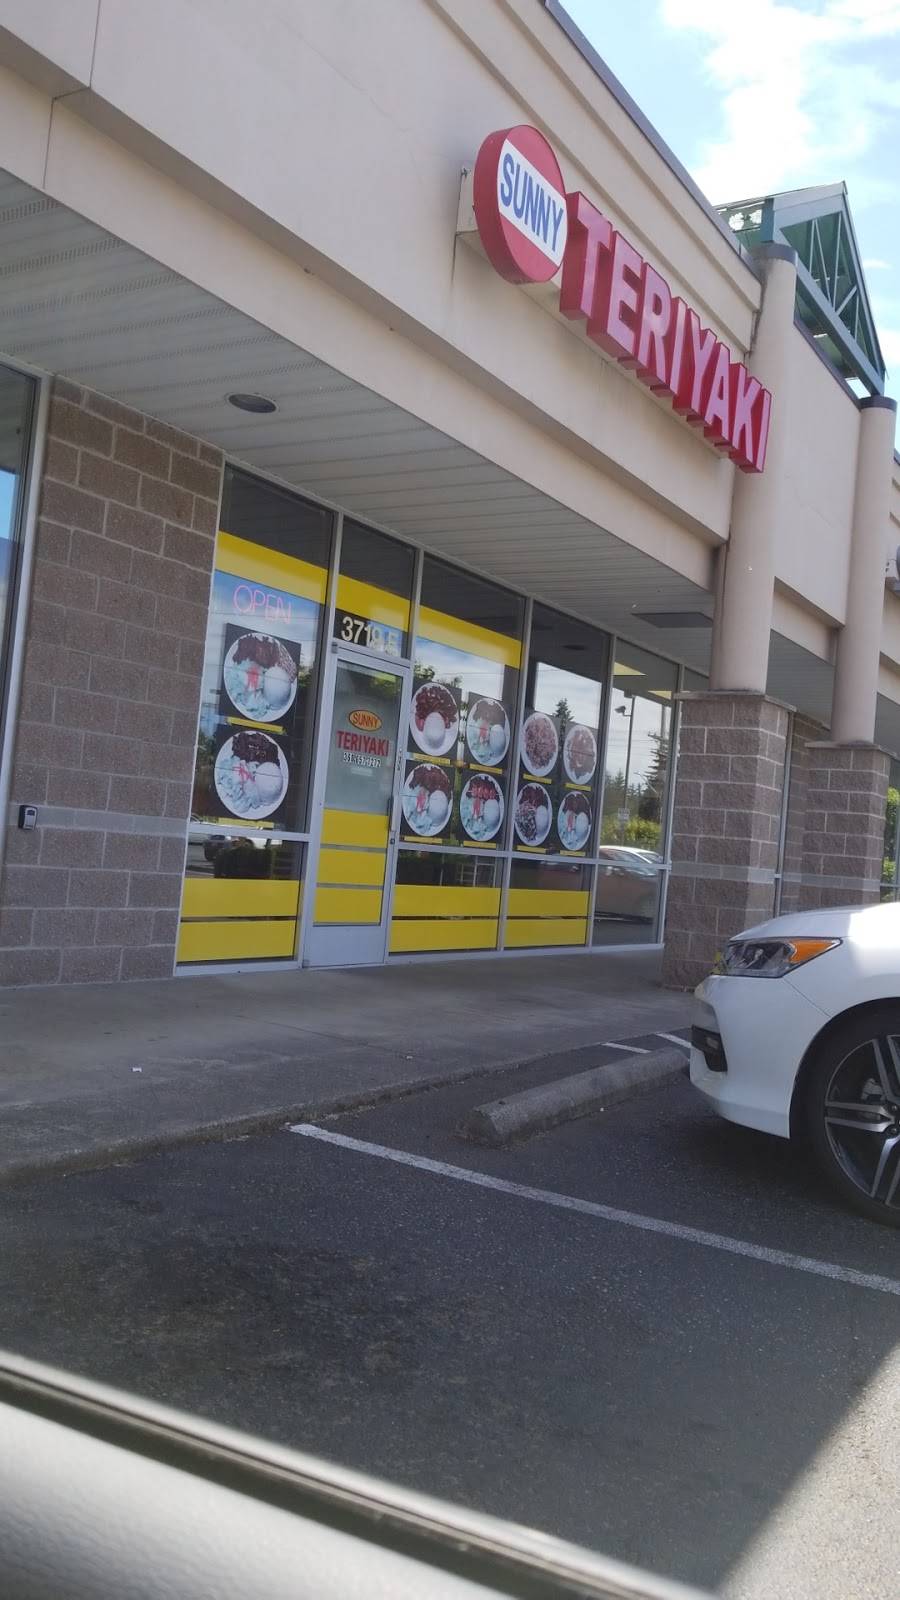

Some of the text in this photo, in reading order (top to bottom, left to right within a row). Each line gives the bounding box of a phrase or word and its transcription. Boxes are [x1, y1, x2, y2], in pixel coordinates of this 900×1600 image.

[499, 152, 565, 253] SUNNY
[561, 191, 772, 473] TERIYAKI
[232, 584, 292, 625] OPEN
[352, 712, 379, 729] SUNNY
[336, 730, 389, 757] TERIYAKI
